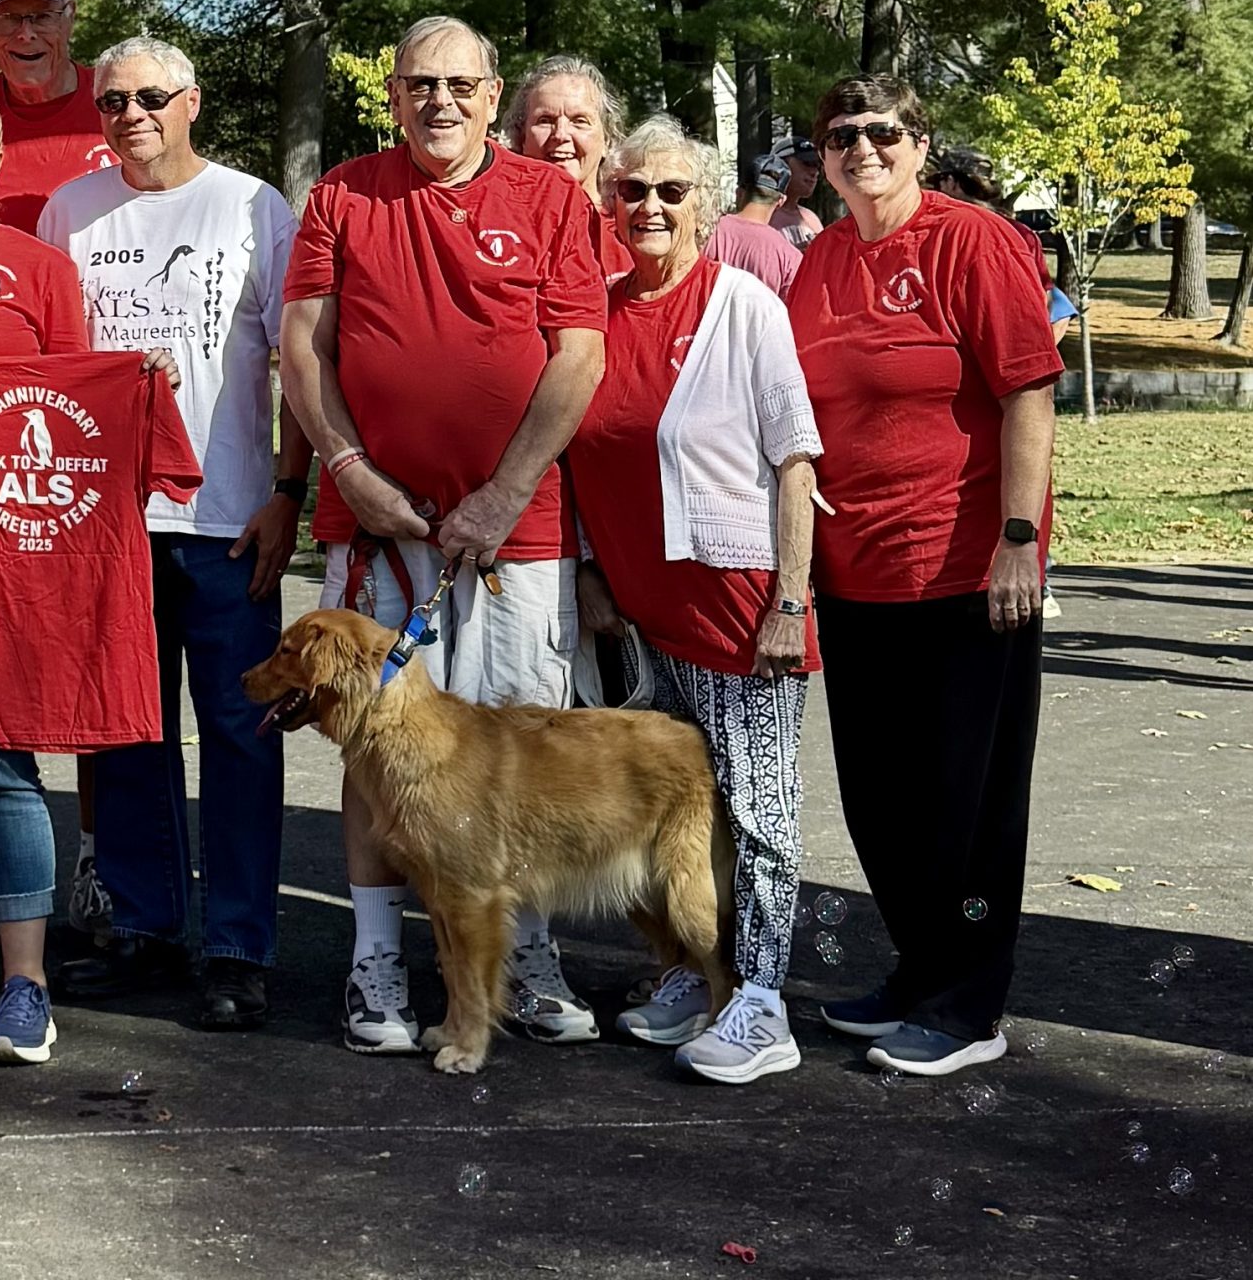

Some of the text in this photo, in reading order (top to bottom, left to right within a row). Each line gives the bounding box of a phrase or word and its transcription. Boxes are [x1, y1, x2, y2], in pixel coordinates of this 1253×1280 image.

[90, 249, 145, 266] 2005
[101, 321, 196, 341] Maureen's
[11, 455, 31, 470] TO
[56, 457, 109, 473] DEFEAT
[60, 488, 102, 530] TEAM
[18, 538, 53, 551] 2025
